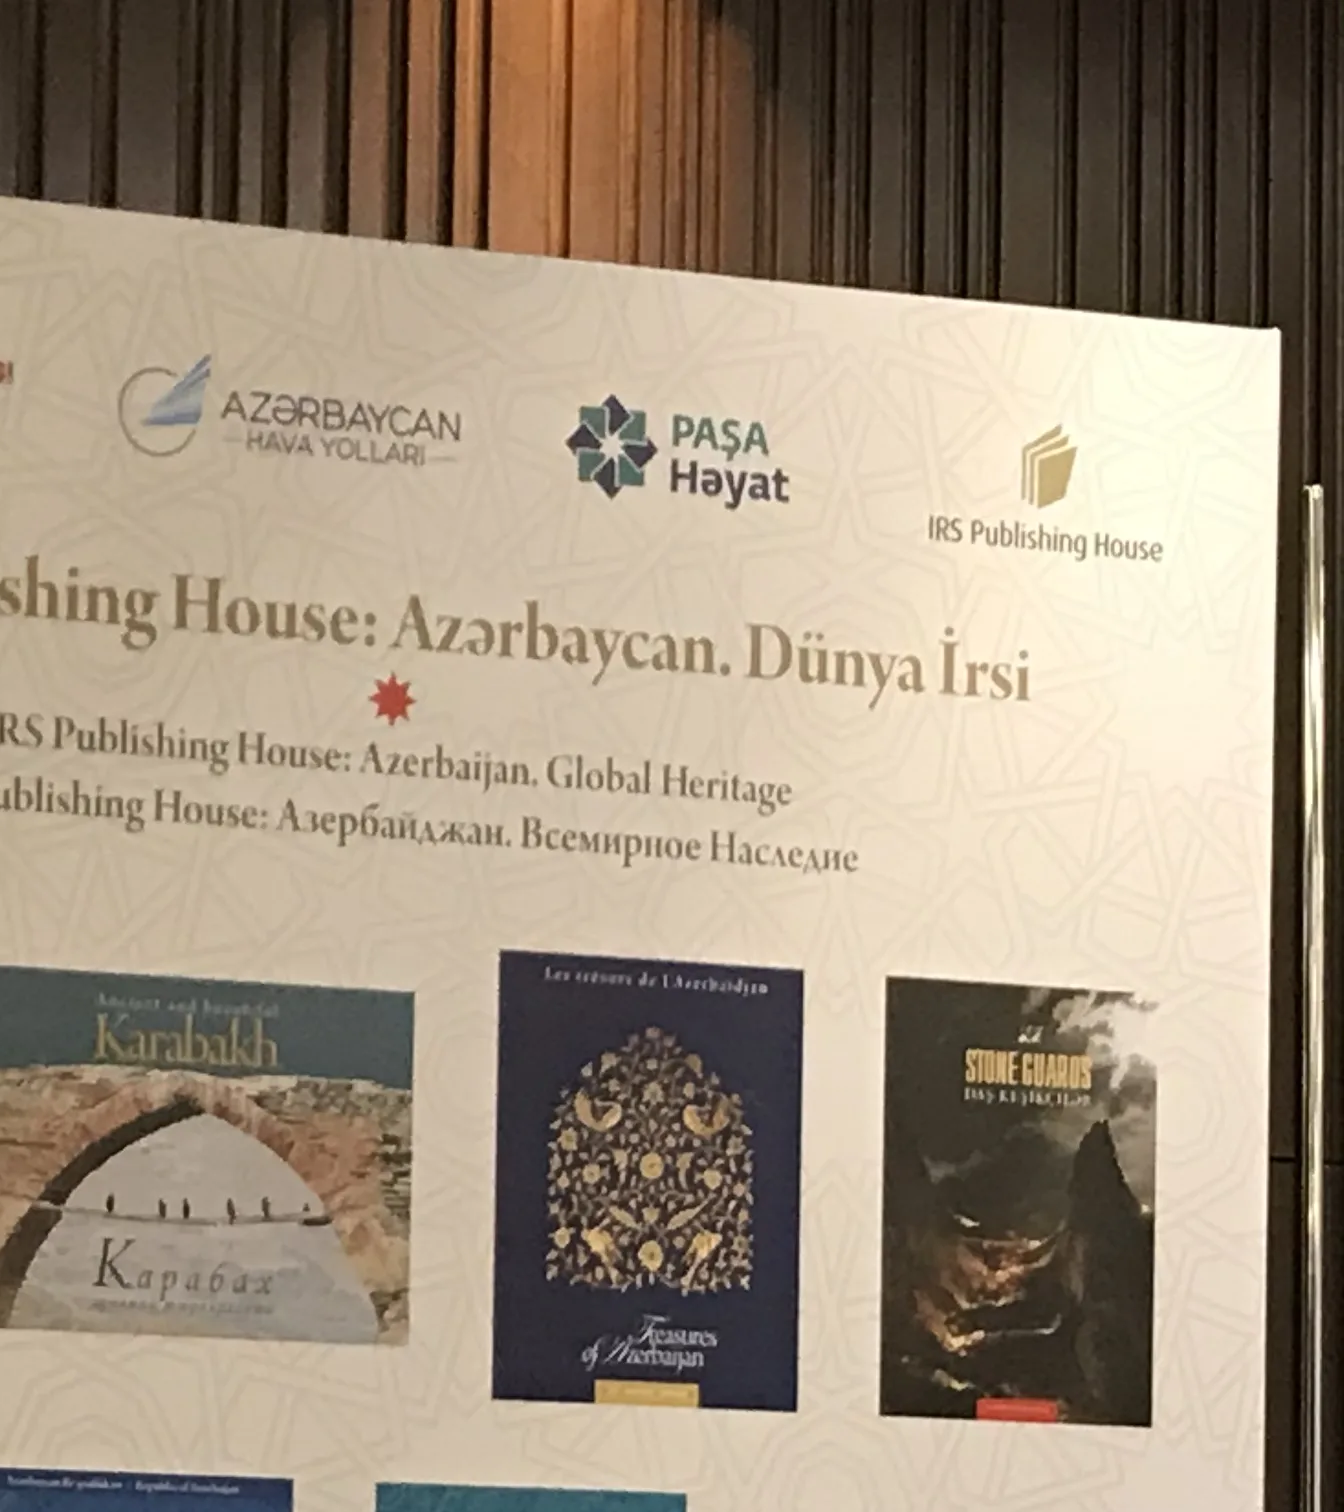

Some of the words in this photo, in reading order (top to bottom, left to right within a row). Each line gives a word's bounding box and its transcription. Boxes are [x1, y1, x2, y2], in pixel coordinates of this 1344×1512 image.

[220, 390, 461, 441] AZƏRBAYCAN
[673, 413, 769, 462] PAŞA
[246, 428, 314, 456] HAVA
[322, 437, 426, 467] YOLLARI
[669, 460, 790, 510] Həyat
[928, 515, 963, 543] IRS
[971, 519, 1087, 562] Publishing
[1094, 531, 1163, 563] House
[170, 572, 378, 649] House:
[390, 594, 731, 687] Azərbaycan.
[745, 622, 925, 710] Dünya
[938, 626, 1030, 702] İrsi
[52, 713, 230, 774] Publishing
[236, 732, 352, 773] House:
[358, 742, 539, 796] Azerbaijan.
[546, 754, 652, 797] Global
[662, 769, 792, 817] Heritage
[152, 787, 268, 830] House:
[275, 801, 512, 848] Азербайджан.
[520, 816, 702, 868] Всемирное
[710, 831, 859, 874] Наследие
[94, 1013, 278, 1067] Karabakh
[965, 1048, 1019, 1086] STONE
[1022, 1052, 1092, 1090] GUARDS
[92, 1237, 273, 1302] Карабах
[639, 1313, 718, 1347] Treasures
